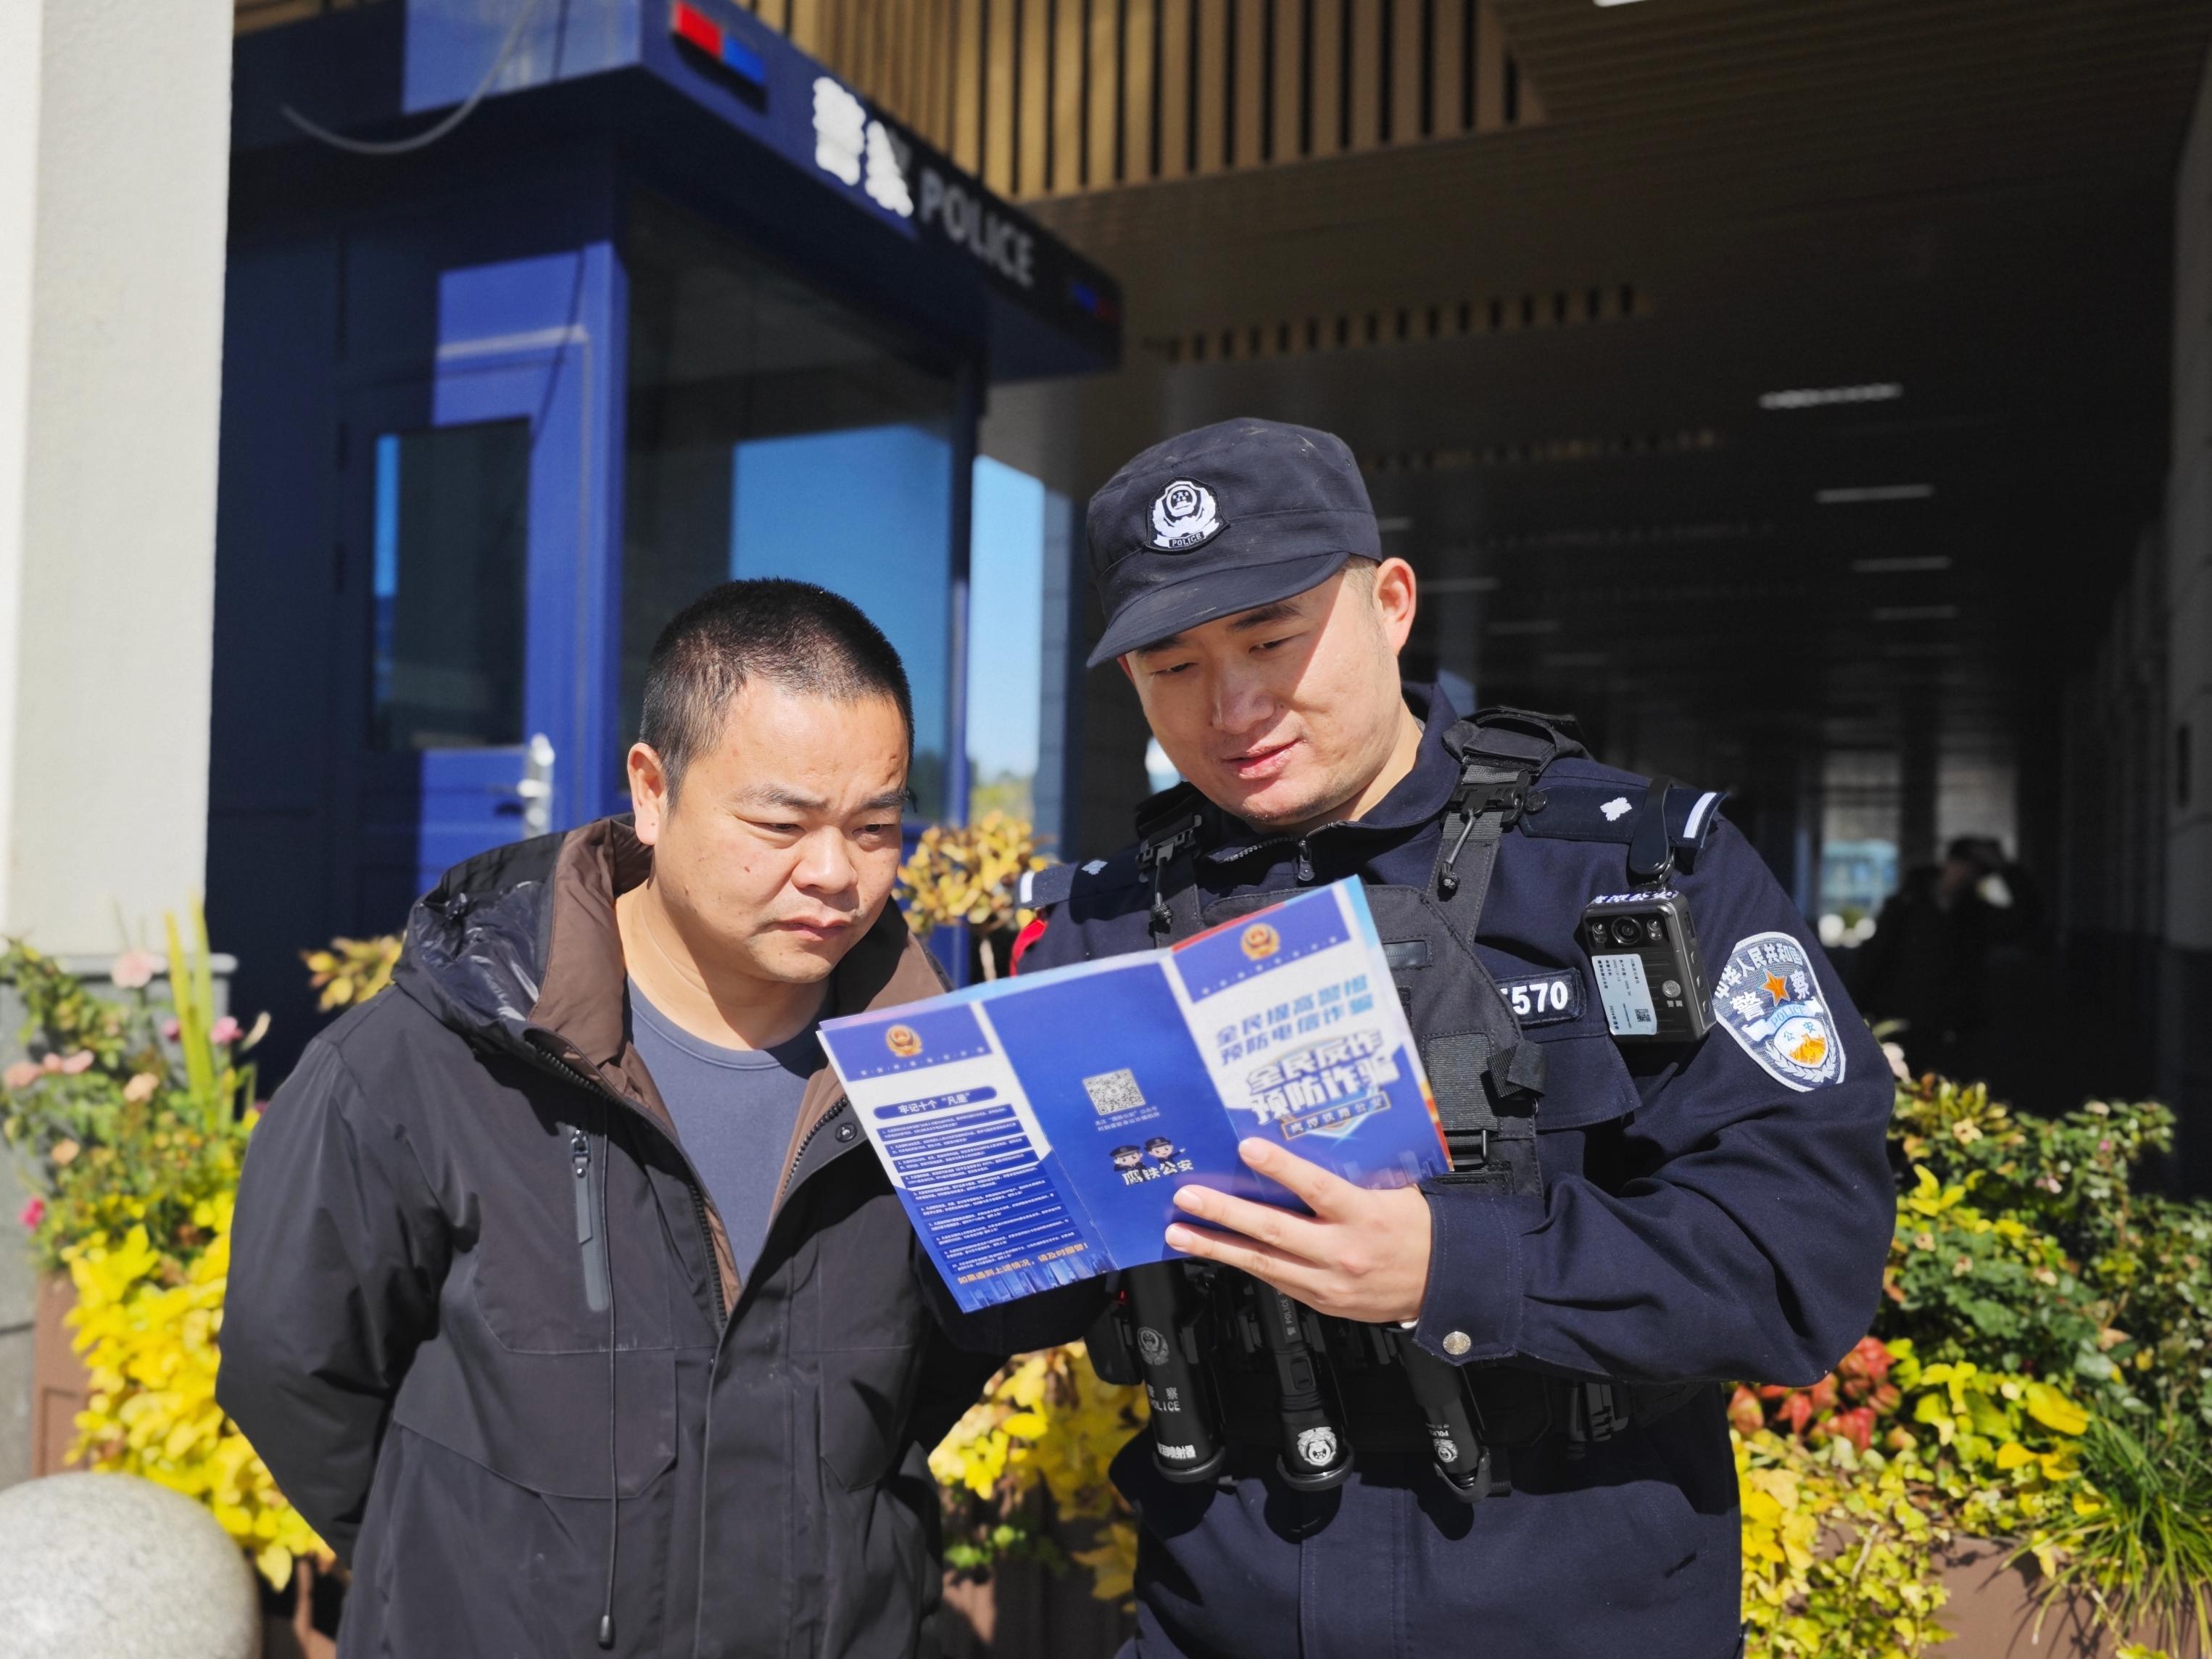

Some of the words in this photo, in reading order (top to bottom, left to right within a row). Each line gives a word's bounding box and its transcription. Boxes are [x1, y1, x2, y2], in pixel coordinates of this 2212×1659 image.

[919, 167, 1033, 286] POLICE
[1172, 532, 1201, 547] POLICE
[1715, 943, 1803, 998] 中华人民共和国
[1500, 981, 1568, 1014] 570
[1771, 1005, 1805, 1027] POLICE
